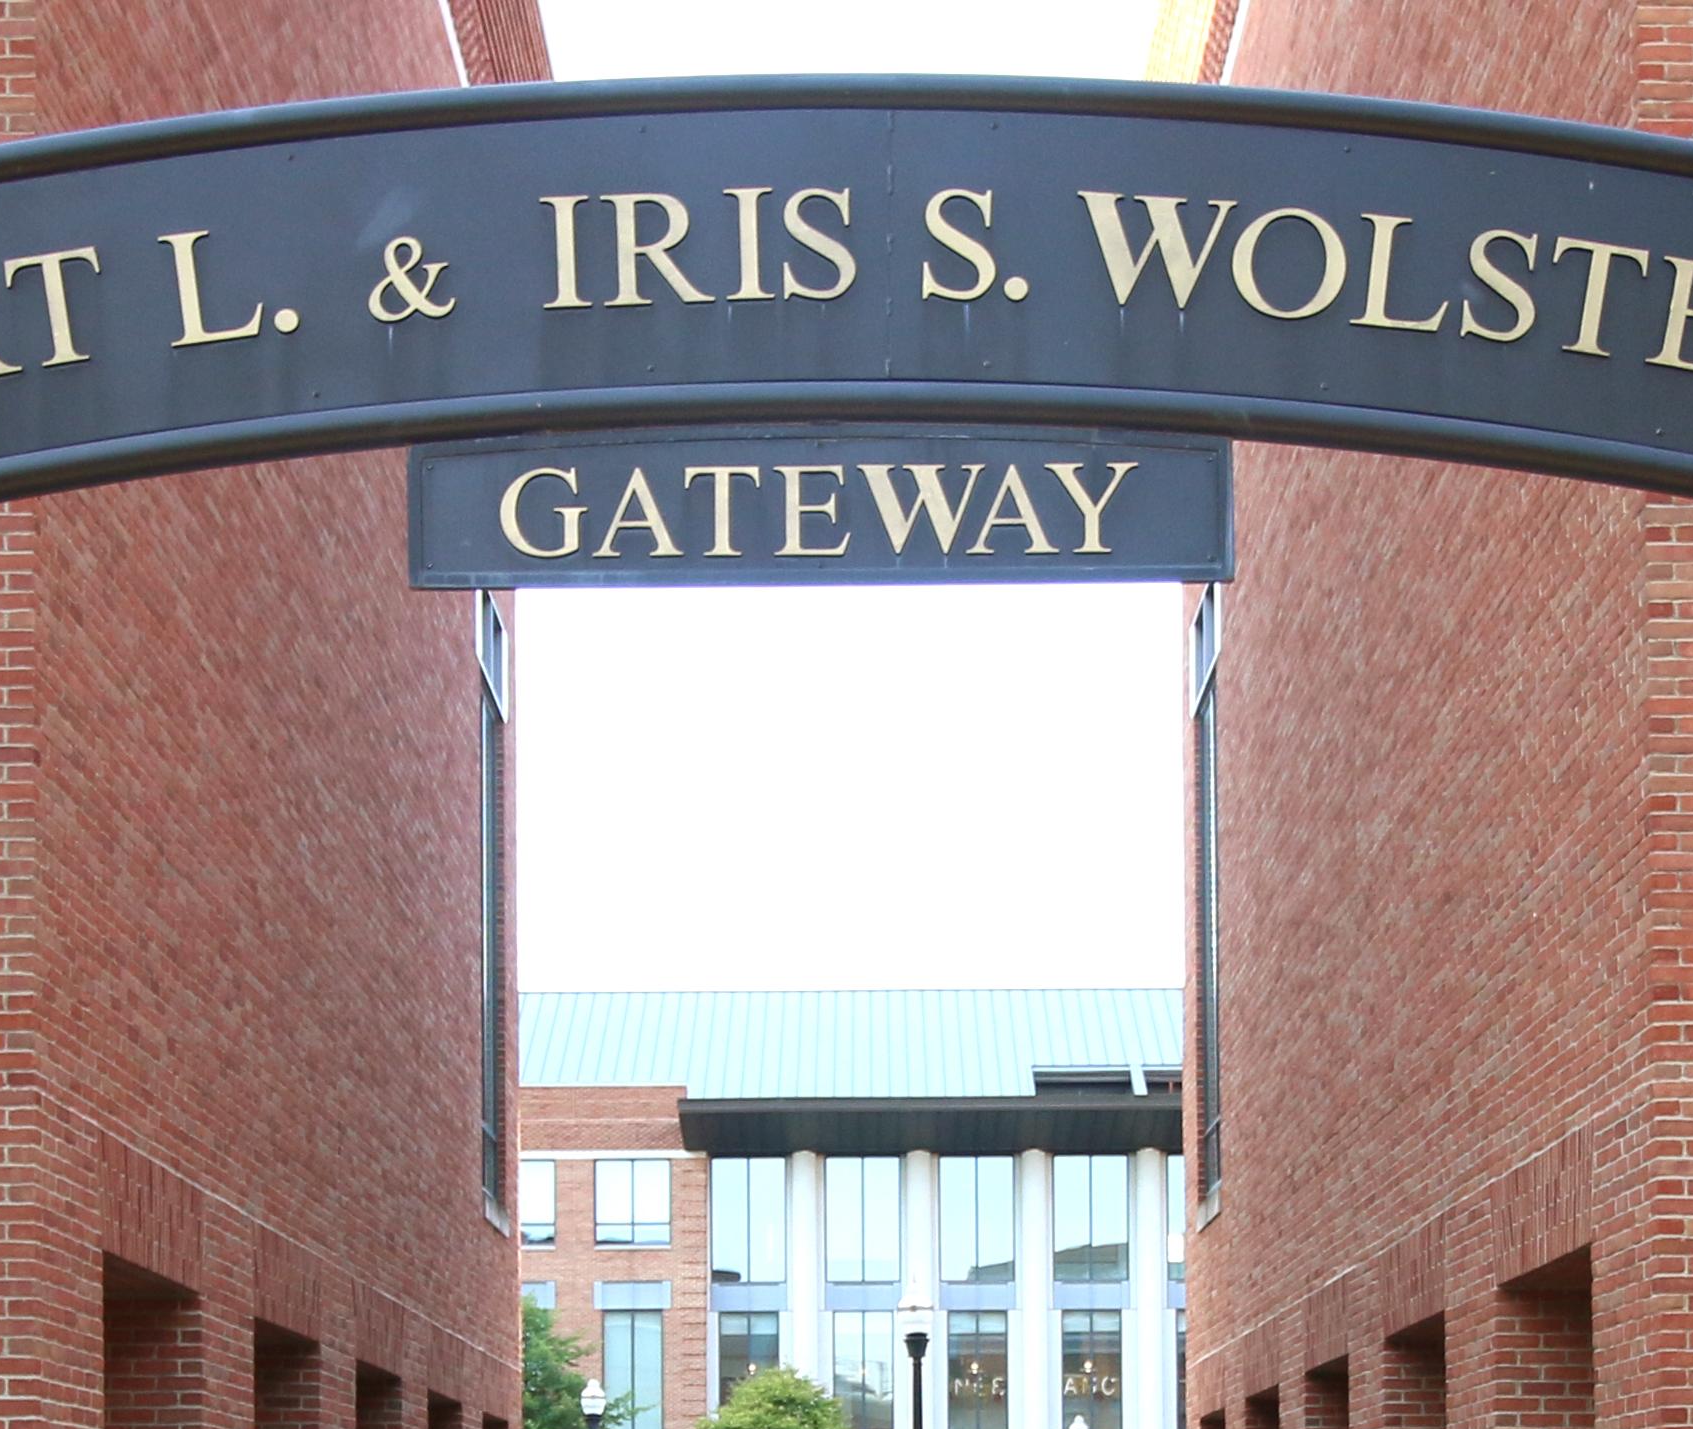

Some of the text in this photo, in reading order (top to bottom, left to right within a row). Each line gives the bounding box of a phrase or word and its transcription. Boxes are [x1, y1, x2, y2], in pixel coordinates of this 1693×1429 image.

[158, 229, 301, 348] L.
[367, 236, 457, 323] &
[540, 186, 858, 309] IRIS
[921, 188, 1030, 302] S.
[499, 461, 1140, 559] GATEWAY
